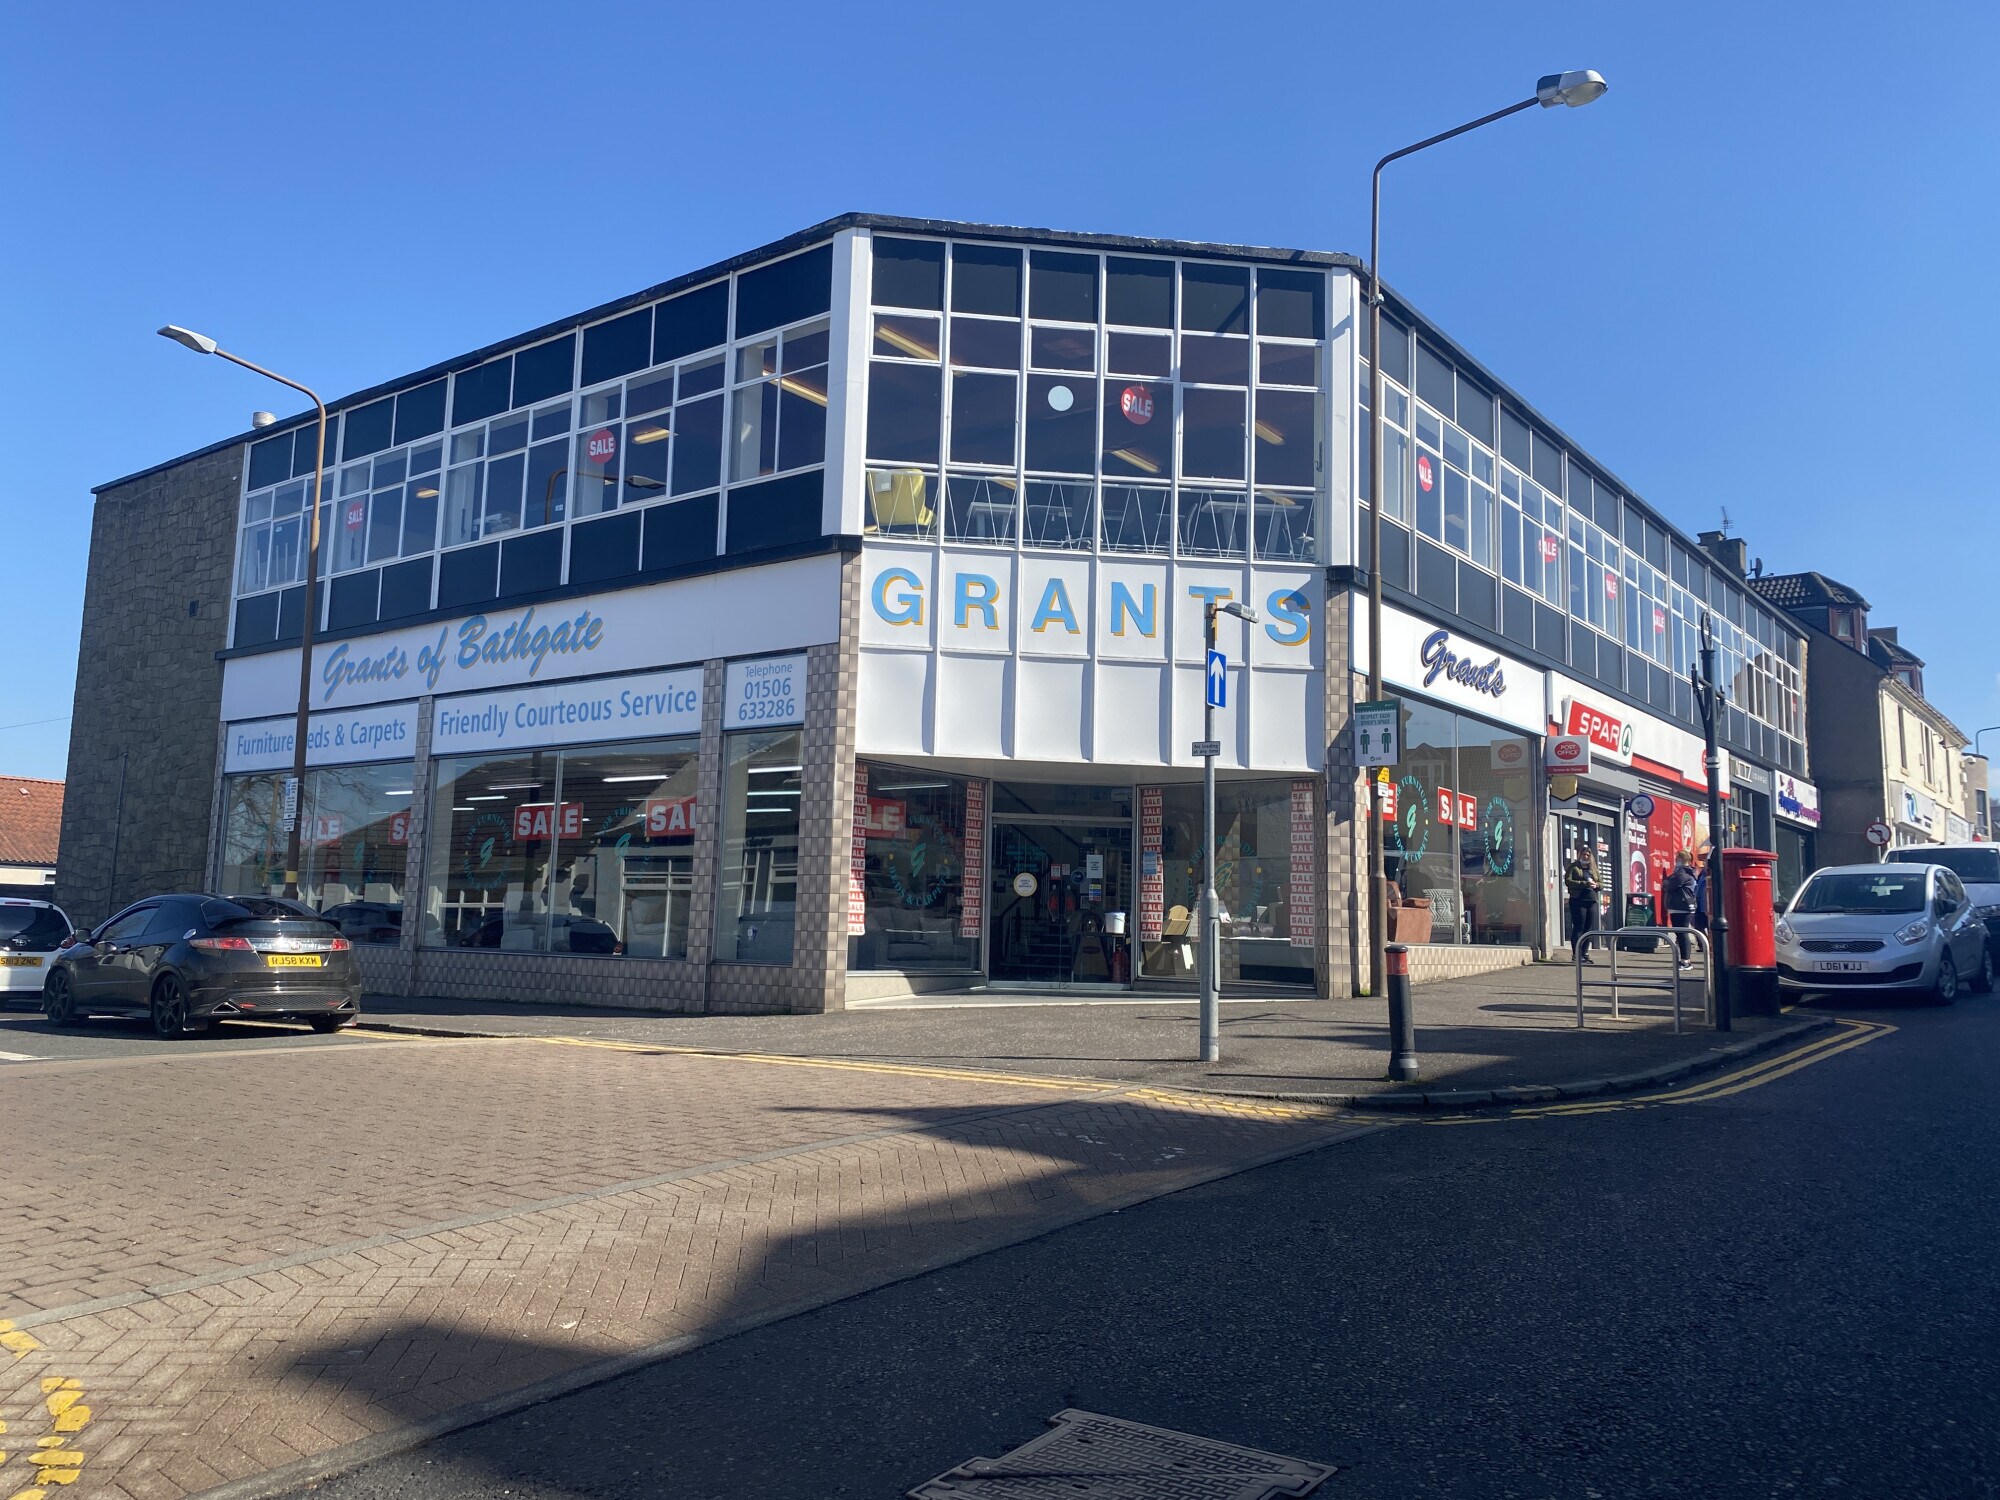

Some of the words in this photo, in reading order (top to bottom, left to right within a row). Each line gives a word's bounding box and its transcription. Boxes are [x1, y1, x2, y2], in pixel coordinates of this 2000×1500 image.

[1124, 393, 1152, 417] SALE
[590, 437, 614, 456] SALE
[872, 567, 1311, 646] GRANTS
[323, 642, 409, 703] Grants
[418, 625, 448, 691] of
[457, 606, 604, 678] Bathgate
[745, 662, 793, 678] Telephone
[744, 677, 791, 700] 01506
[440, 705, 508, 738] Friendly
[514, 697, 613, 729] Courteous
[620, 683, 698, 719] Service
[739, 698, 795, 720] 633286
[1579, 711, 1620, 747] SPAR
[236, 732, 294, 756] Furniture
[306, 724, 330, 749] eds
[335, 723, 345, 746] &
[350, 718, 406, 749] Carpets
[1292, 782, 1313, 790] SALE
[1143, 788, 1162, 796] SALE
[855, 796, 866, 804] ALE
[968, 800, 982, 808] SALE
[854, 807, 866, 815] ALE
[1292, 803, 1313, 811] SALE
[1440, 794, 1474, 827] SLE
[650, 802, 697, 832] SAL
[967, 810, 981, 818] SALE
[1292, 813, 1313, 821] SALE
[518, 808, 579, 836] SALE
[854, 818, 866, 826] ALE
[967, 820, 981, 828] SALE
[853, 828, 865, 836] ALE
[1143, 827, 1161, 835] SALE
[853, 839, 864, 847] ALE
[1292, 844, 1314, 852] SALE
[852, 849, 864, 857] ALE
[966, 849, 981, 857] SALE
[966, 859, 980, 867] SALE
[1291, 864, 1314, 872] SALE
[1291, 874, 1314, 882] SALE
[965, 879, 980, 887] SALE
[1291, 885, 1314, 893] SALE
[1291, 895, 1314, 903] SALE
[1143, 903, 1162, 911] SALE
[1291, 906, 1314, 914] SALE
[1291, 916, 1314, 924] SALE
[1142, 923, 1162, 931] SALE
[1291, 927, 1314, 935] SALE
[1291, 937, 1314, 945] SALE
[20, 957, 38, 966] ZNC
[272, 956, 297, 965] RJ58
[1820, 962, 1842, 971] LD61
